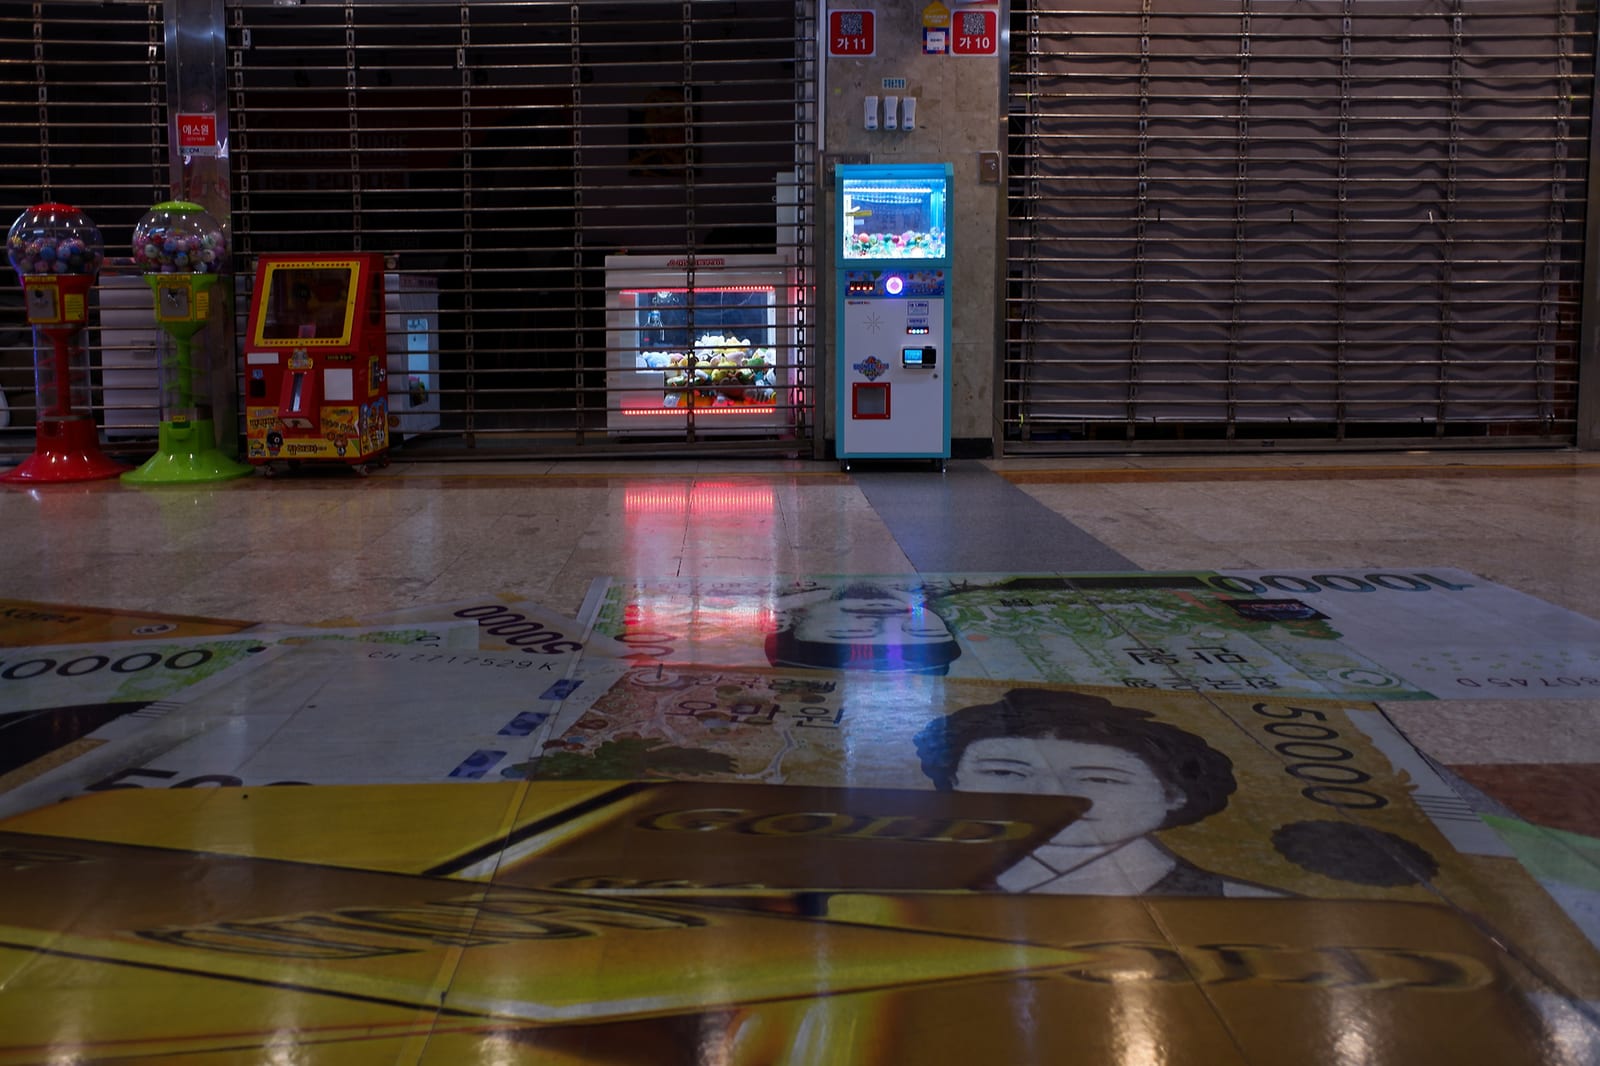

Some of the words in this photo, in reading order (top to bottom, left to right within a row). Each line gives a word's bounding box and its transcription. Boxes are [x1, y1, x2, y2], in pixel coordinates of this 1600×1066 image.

[837, 37, 849, 50] 가
[853, 38, 867, 50] 11
[959, 37, 971, 49] 가
[975, 38, 990, 49] 10
[182, 124, 209, 136] 에스원
[1207, 566, 1475, 594] 10000
[453, 604, 584, 656] 50000
[0, 648, 214, 681] 0000
[1251, 702, 1390, 811] 50000
[636, 807, 1034, 845] GOLD
[1050, 942, 1495, 993] OLD
